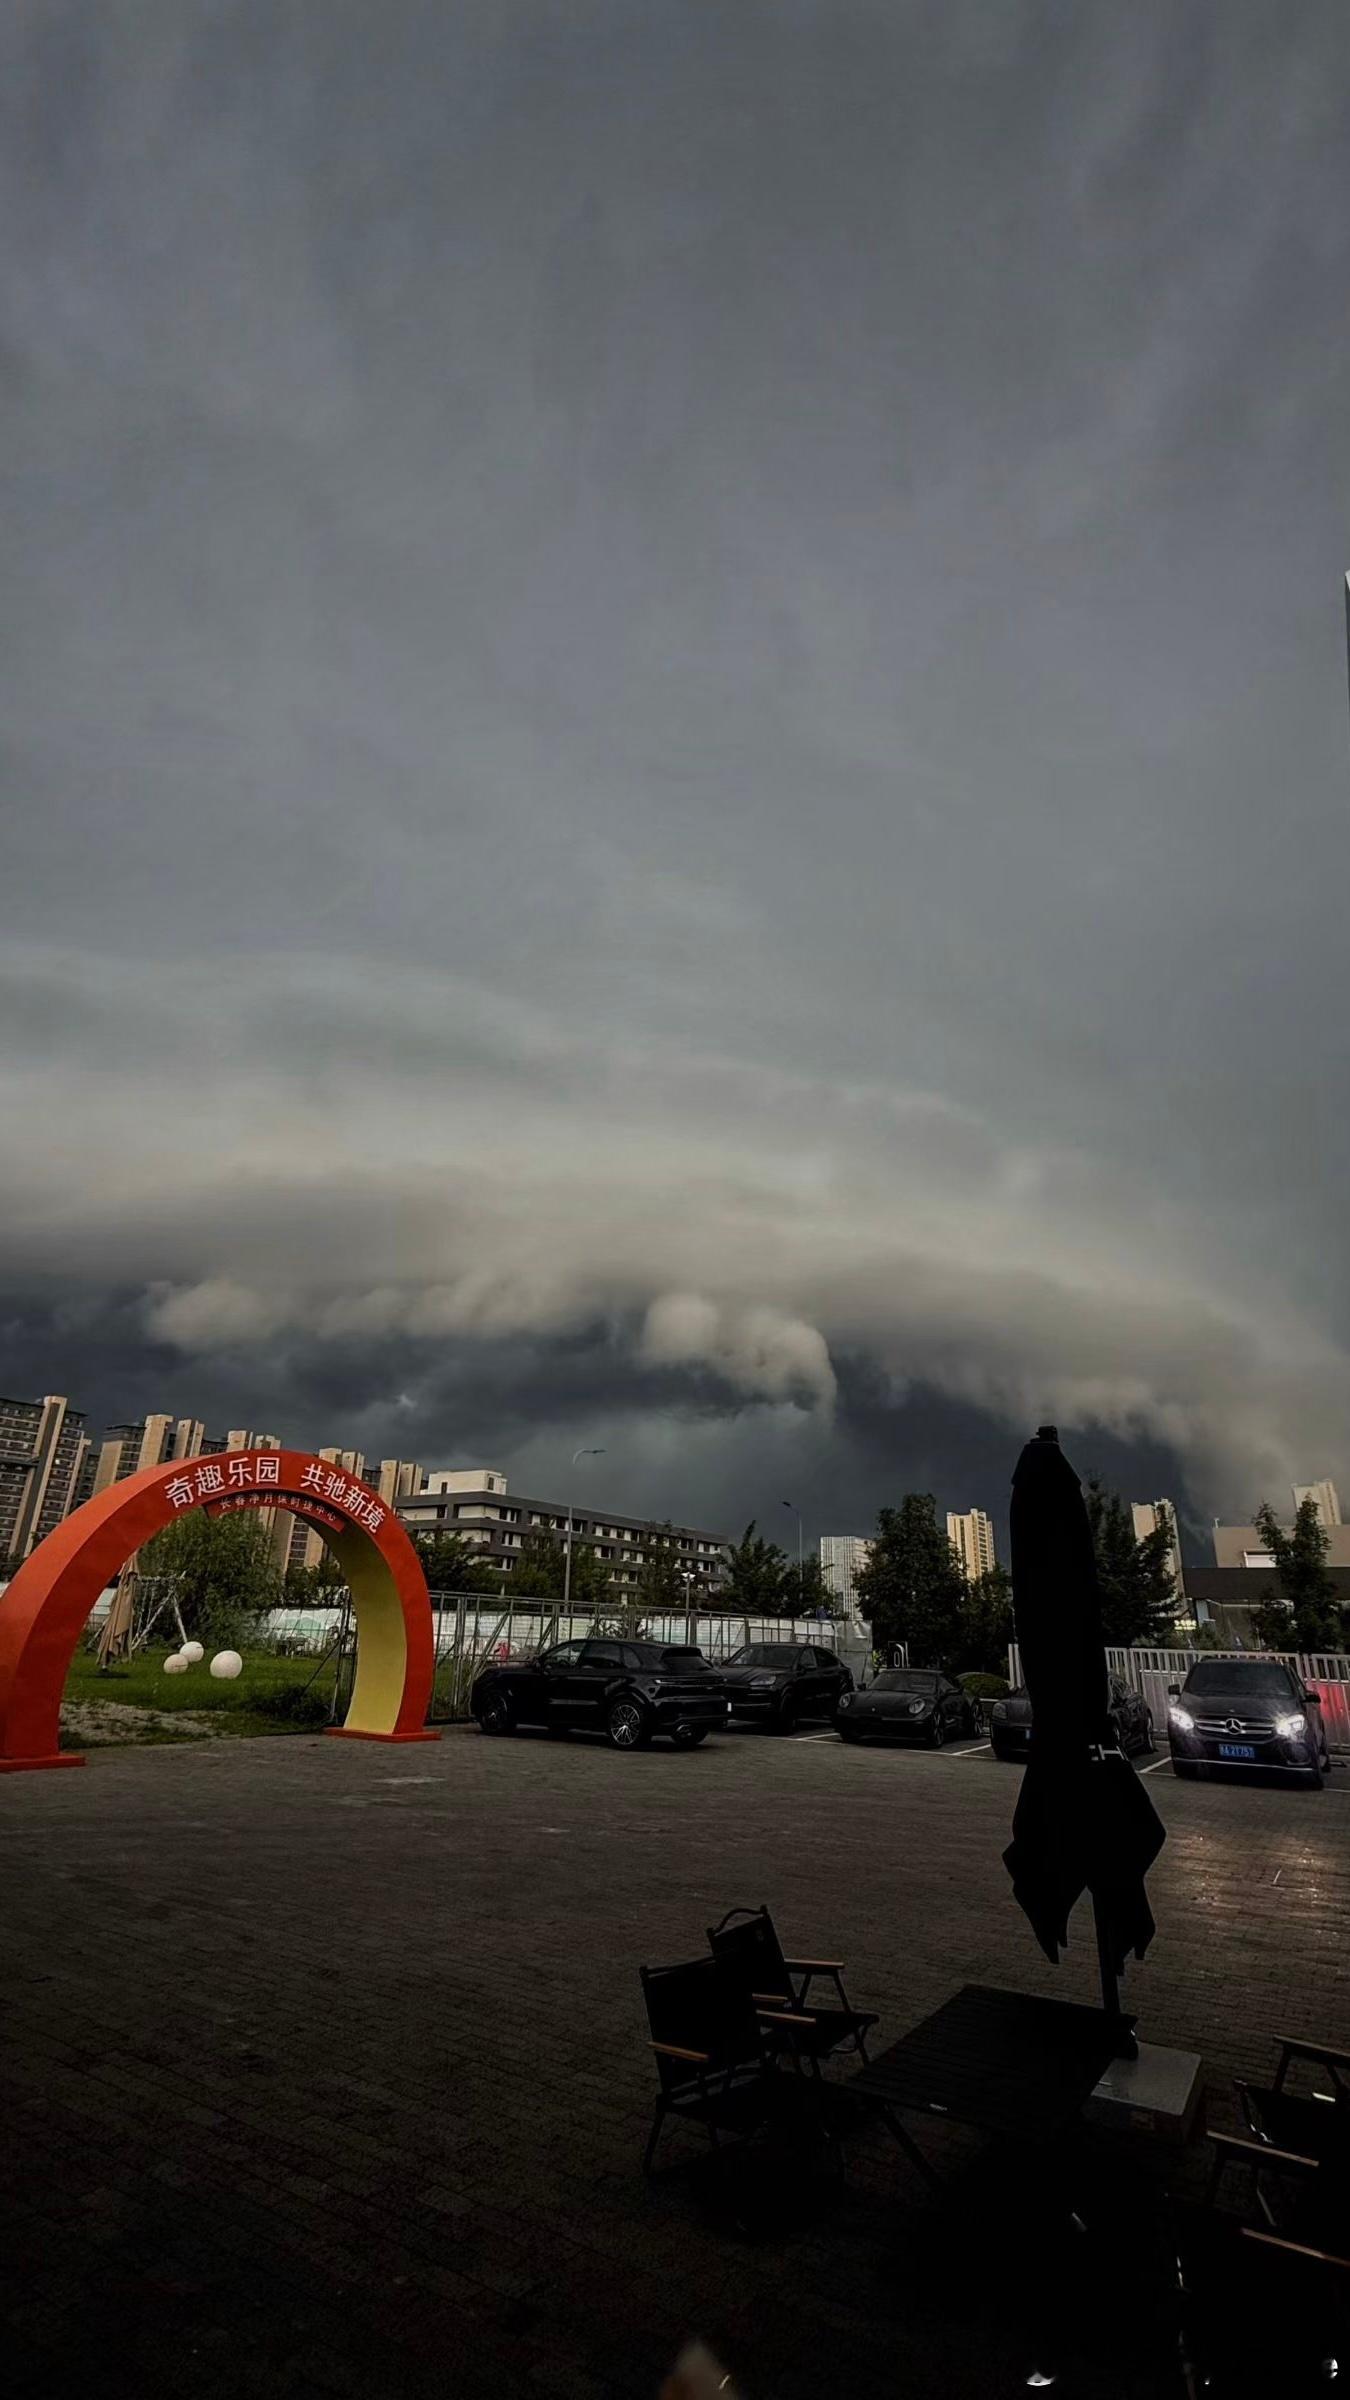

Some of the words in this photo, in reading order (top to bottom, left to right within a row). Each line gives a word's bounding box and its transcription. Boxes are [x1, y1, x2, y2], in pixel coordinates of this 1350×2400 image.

[165, 1457, 280, 1508] 奇趣乐园
[301, 1463, 386, 1533] 共驰新境
